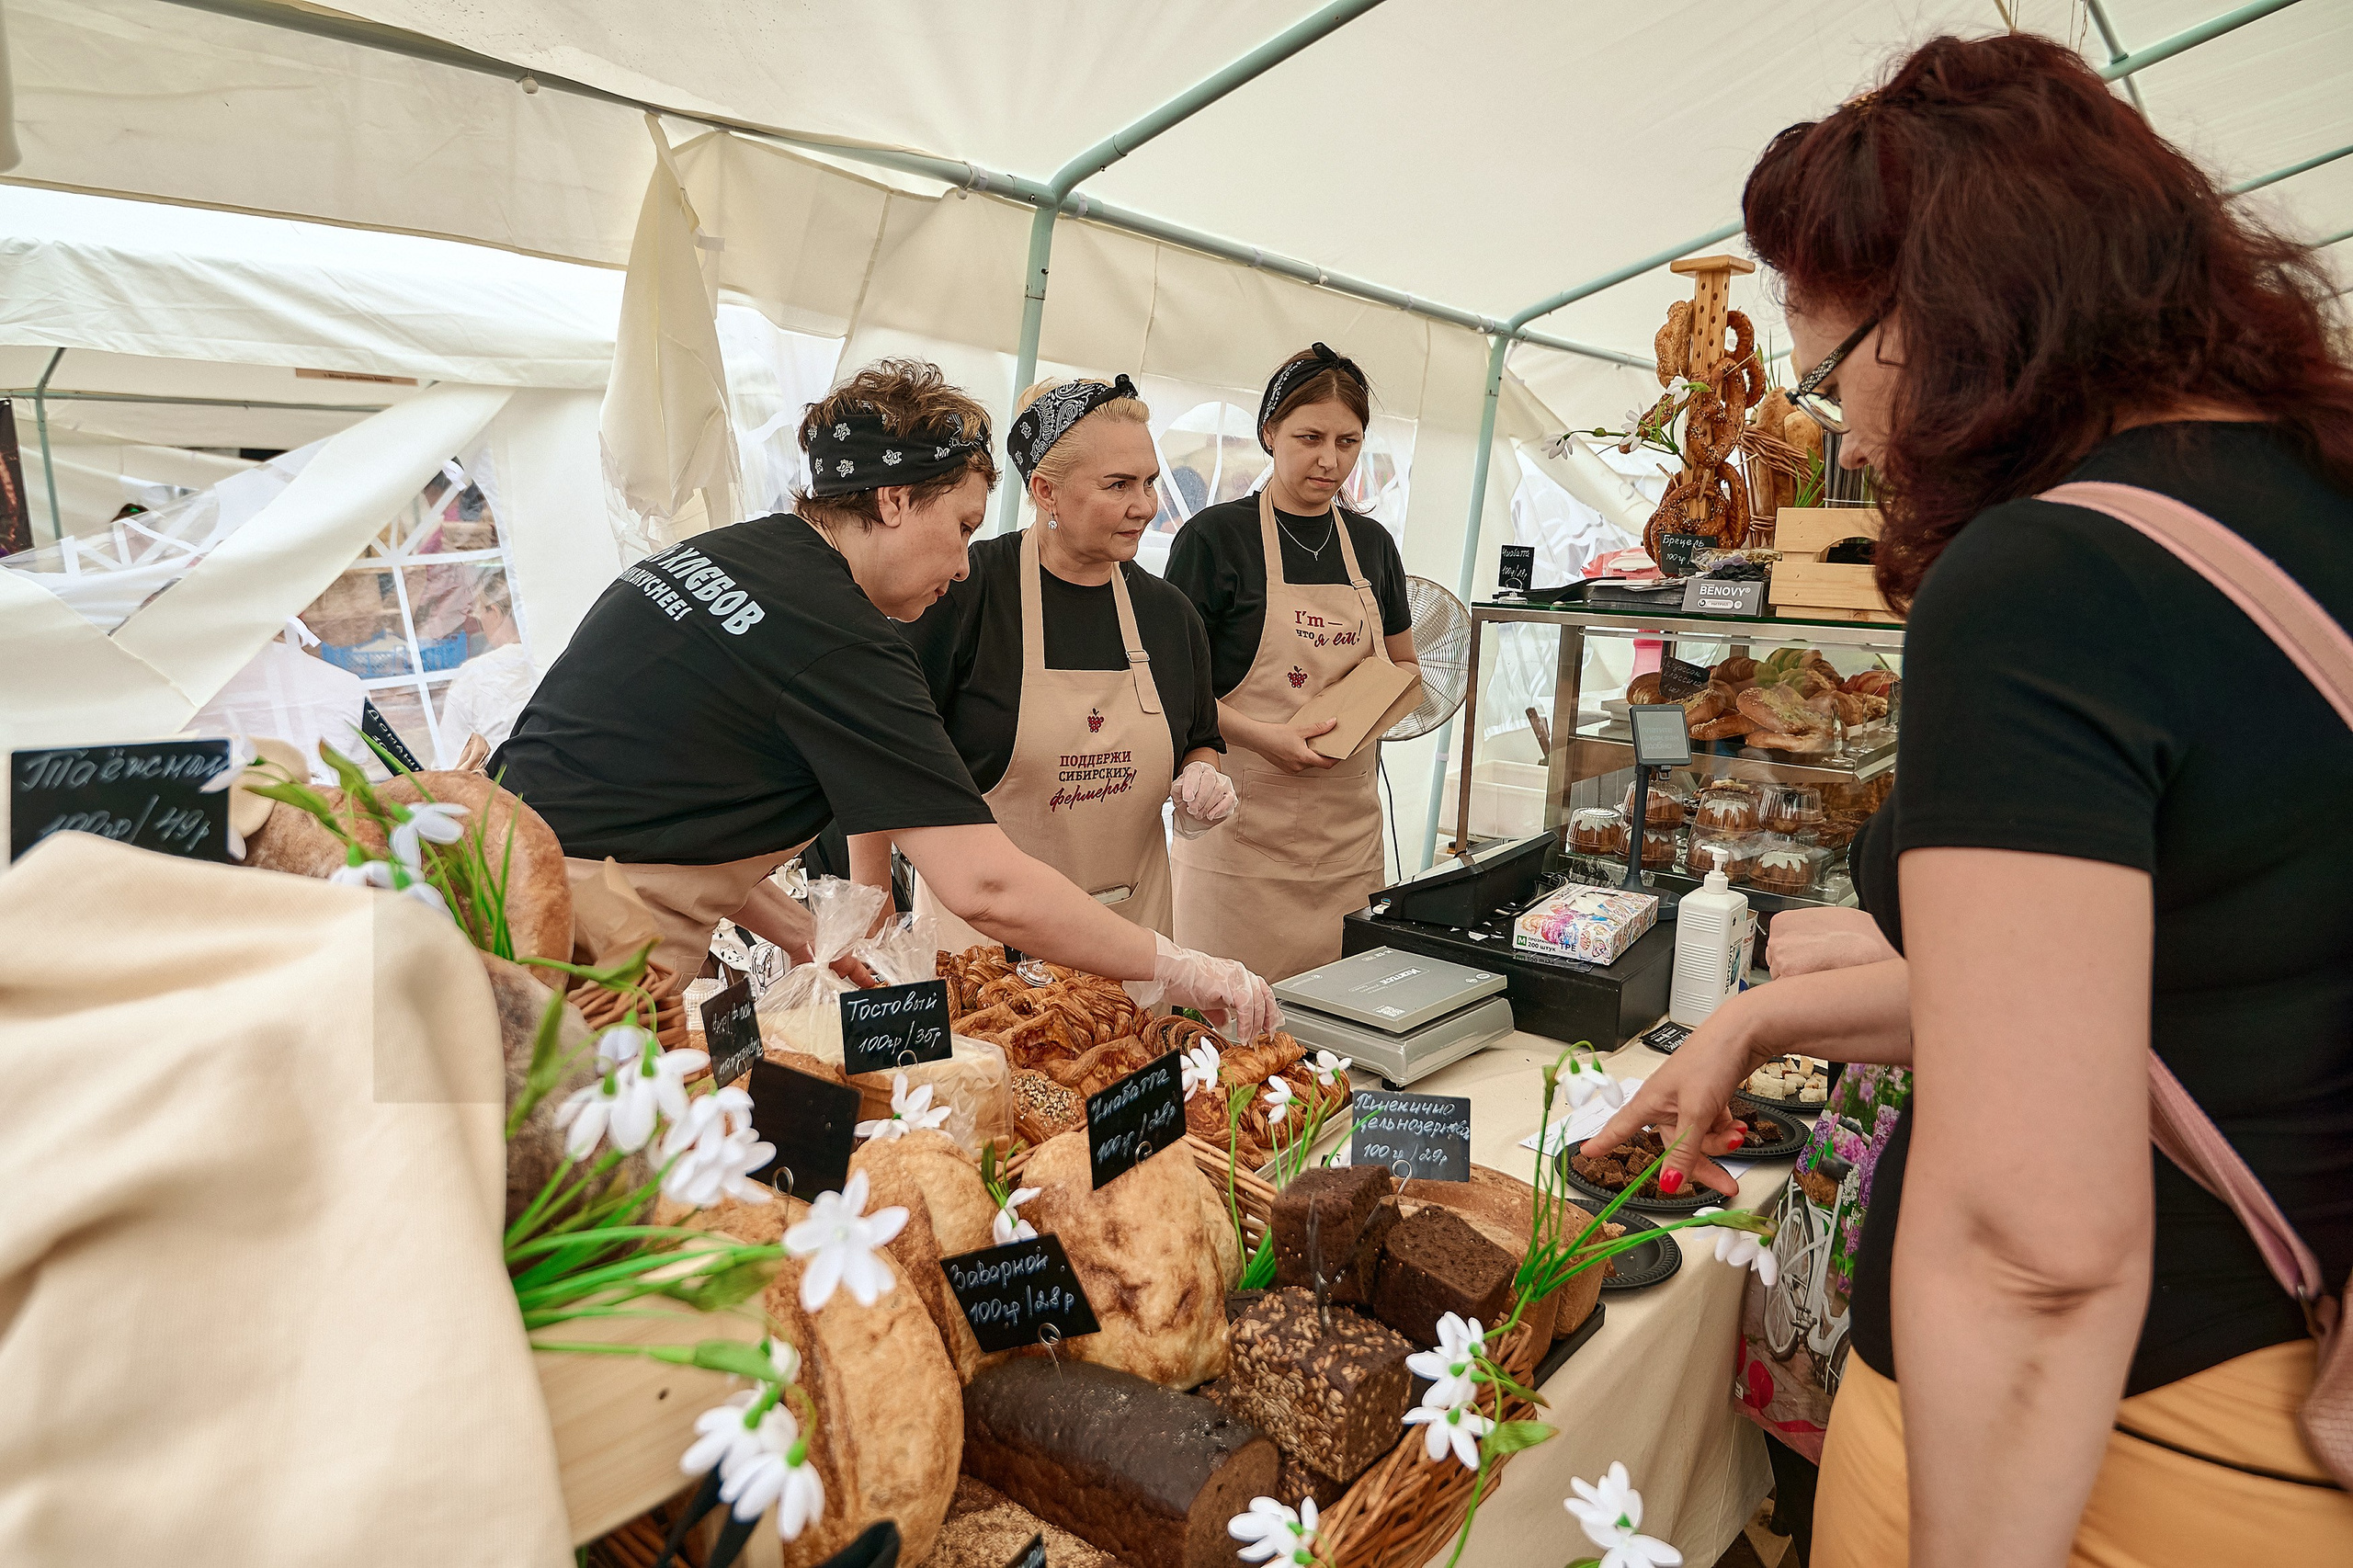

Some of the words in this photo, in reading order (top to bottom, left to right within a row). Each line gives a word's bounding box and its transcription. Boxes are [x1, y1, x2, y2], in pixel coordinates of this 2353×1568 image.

[657, 547, 767, 636] ХЛЕБОВ
[1059, 767, 1131, 782] СИБИРСКИХ
[1060, 751, 1131, 768] ПОДДЕРЖИ
[1050, 769, 1137, 812] фермеров!
[847, 990, 938, 1022] Тостовый
[949, 1246, 1049, 1292] Заварной
